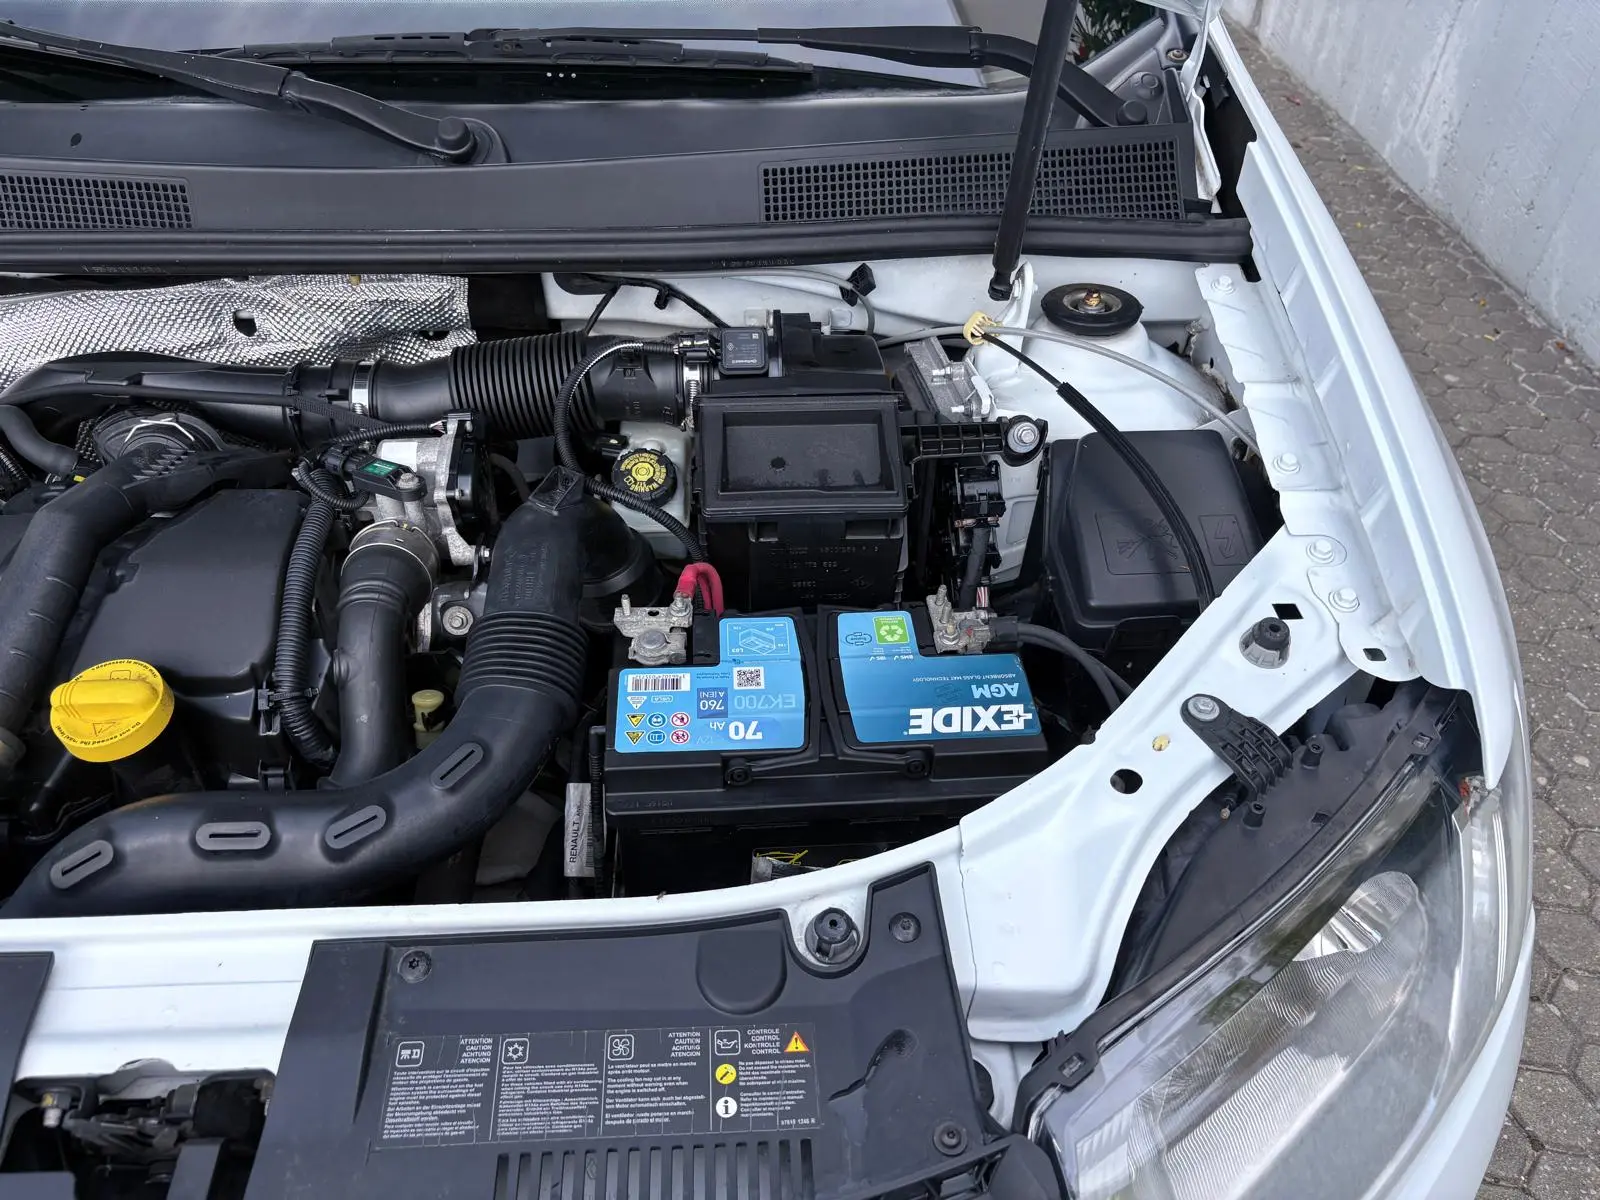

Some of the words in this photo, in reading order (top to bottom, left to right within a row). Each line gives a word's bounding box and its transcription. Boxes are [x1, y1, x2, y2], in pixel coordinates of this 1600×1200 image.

[970, 682, 1019, 699] AGM
[700, 699, 724, 710] 760
[734, 692, 796, 709] EK700
[710, 721, 726, 731] Ah
[908, 704, 1032, 735] EXIDE
[728, 720, 763, 740] 70
[569, 820, 580, 862] RENAULT
